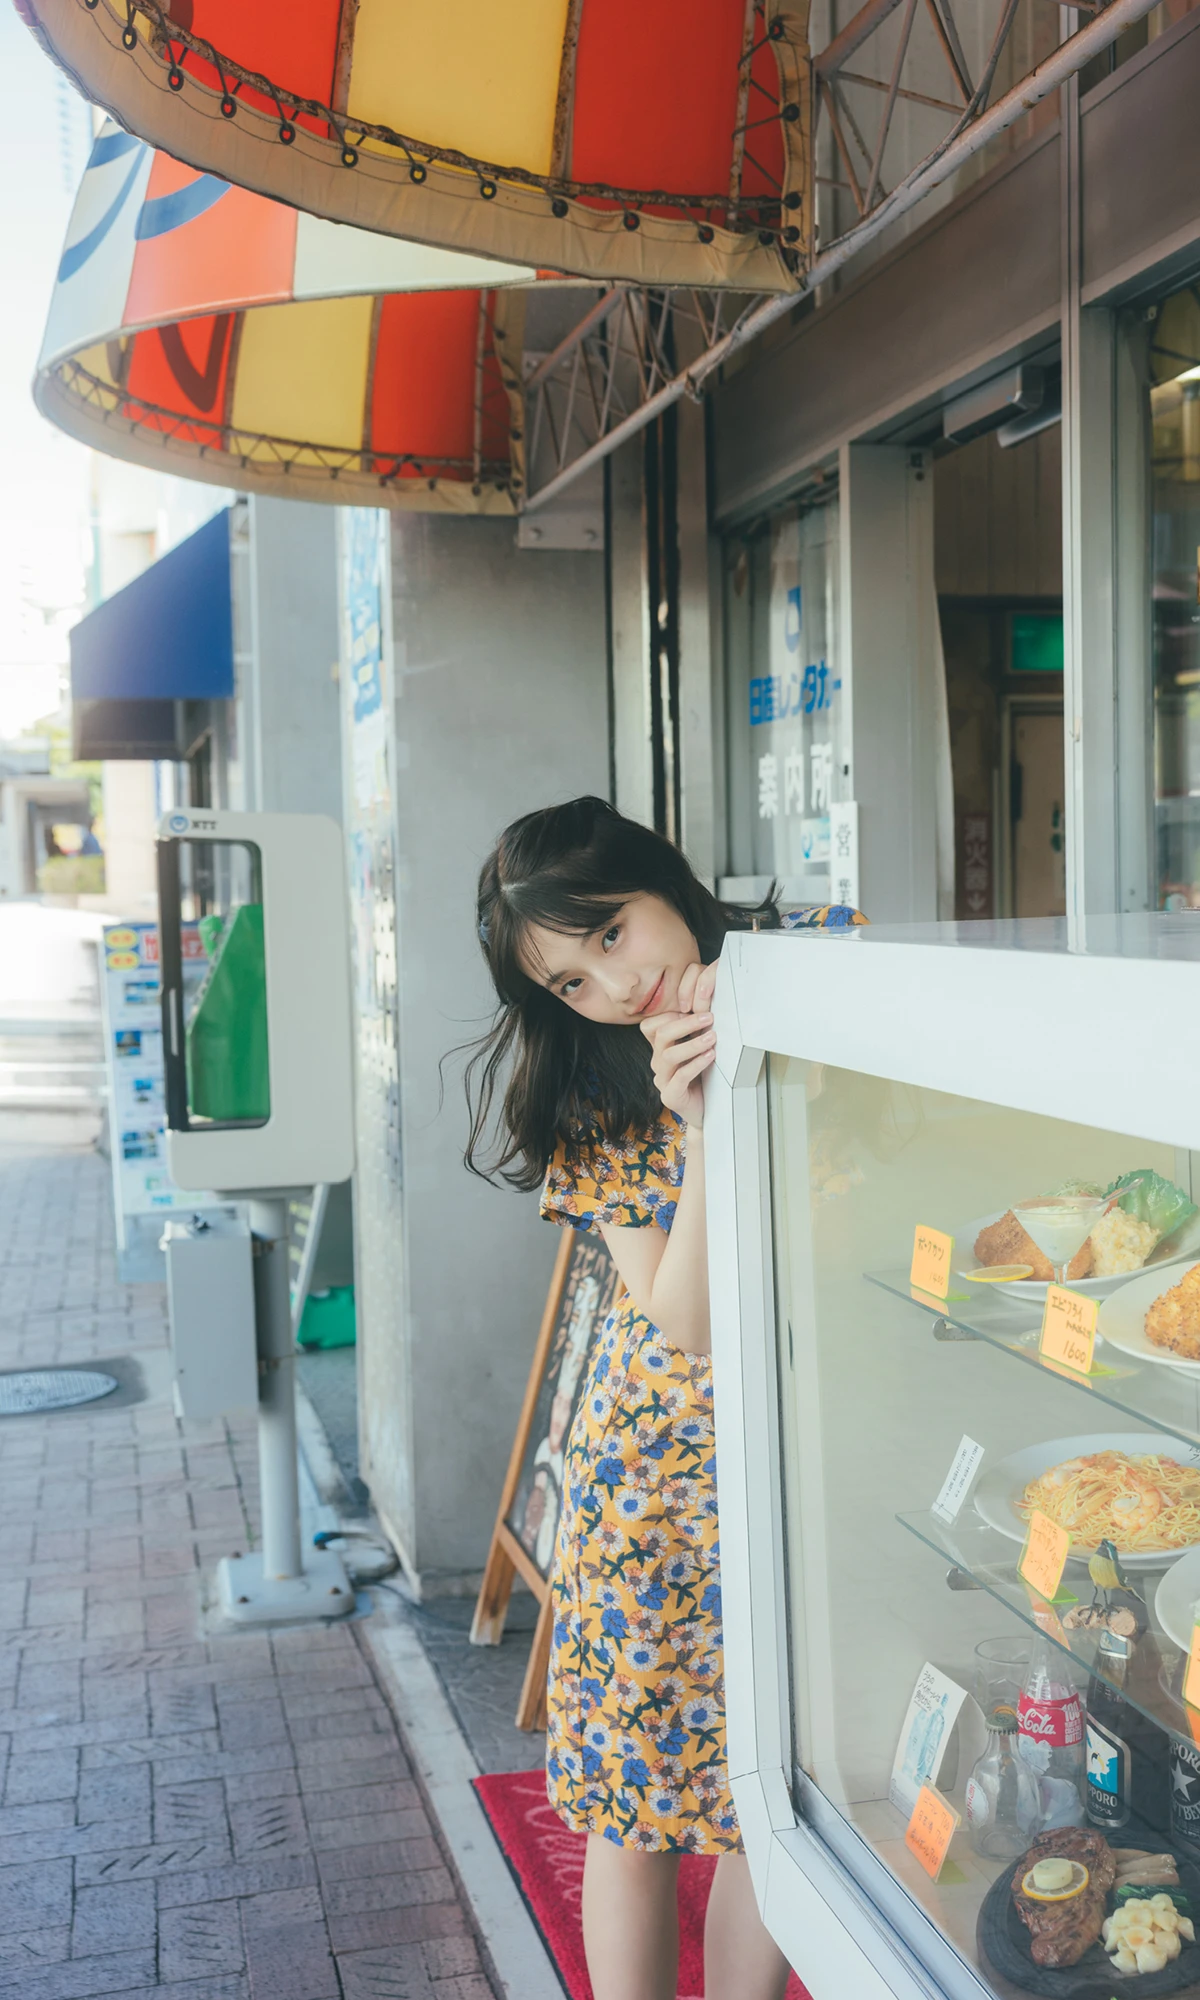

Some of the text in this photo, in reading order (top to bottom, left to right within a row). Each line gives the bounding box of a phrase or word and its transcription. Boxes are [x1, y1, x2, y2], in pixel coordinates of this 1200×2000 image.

[758, 742, 834, 820] 案内所
[1063, 1340, 1087, 1364] 1600
